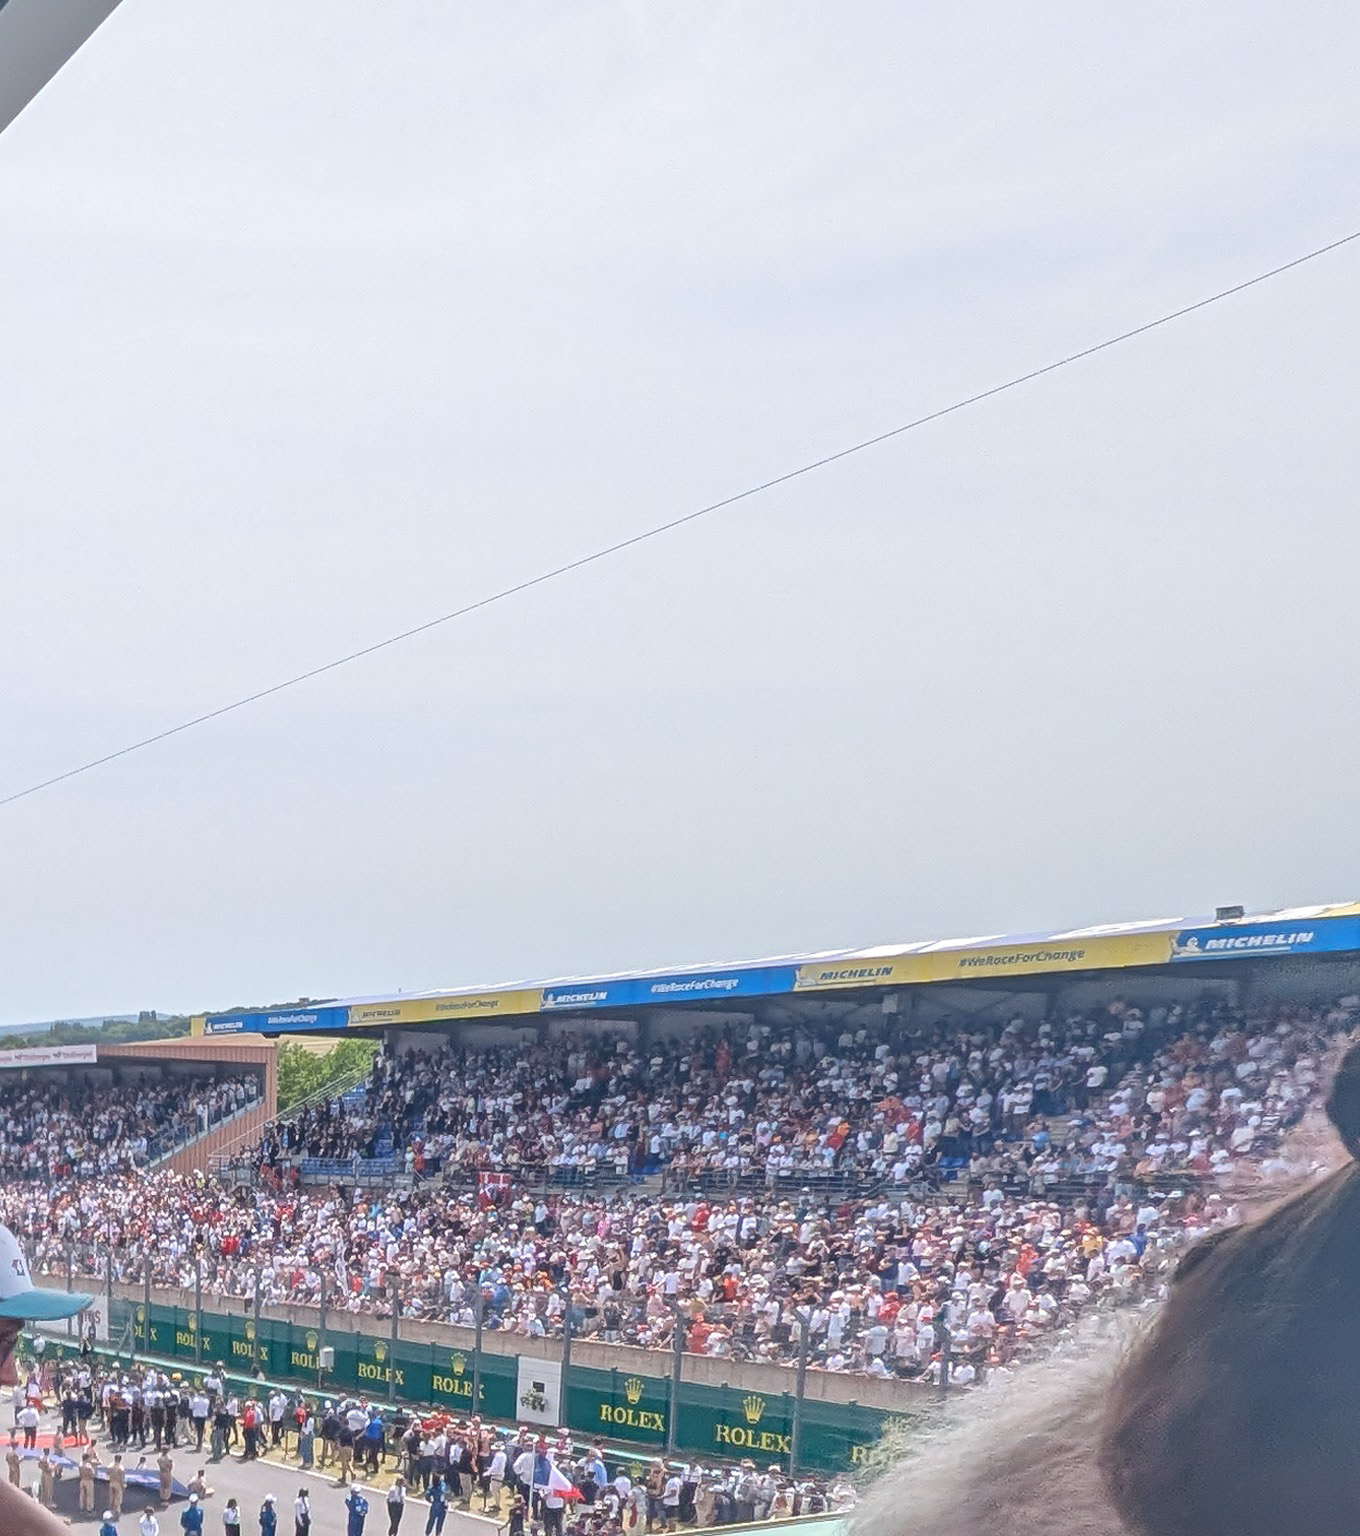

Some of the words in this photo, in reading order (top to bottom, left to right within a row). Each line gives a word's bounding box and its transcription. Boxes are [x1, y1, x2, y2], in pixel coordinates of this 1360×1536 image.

[1204, 932, 1314, 950] MICHELIN
[820, 966, 893, 980] MICHELIN
[958, 949, 1085, 968] #WeRaceForChange
[176, 1331, 212, 1350] ROLX
[232, 1340, 269, 1361] ROLX
[600, 1403, 666, 1432] ROLEX
[715, 1424, 792, 1454] ROLEX
